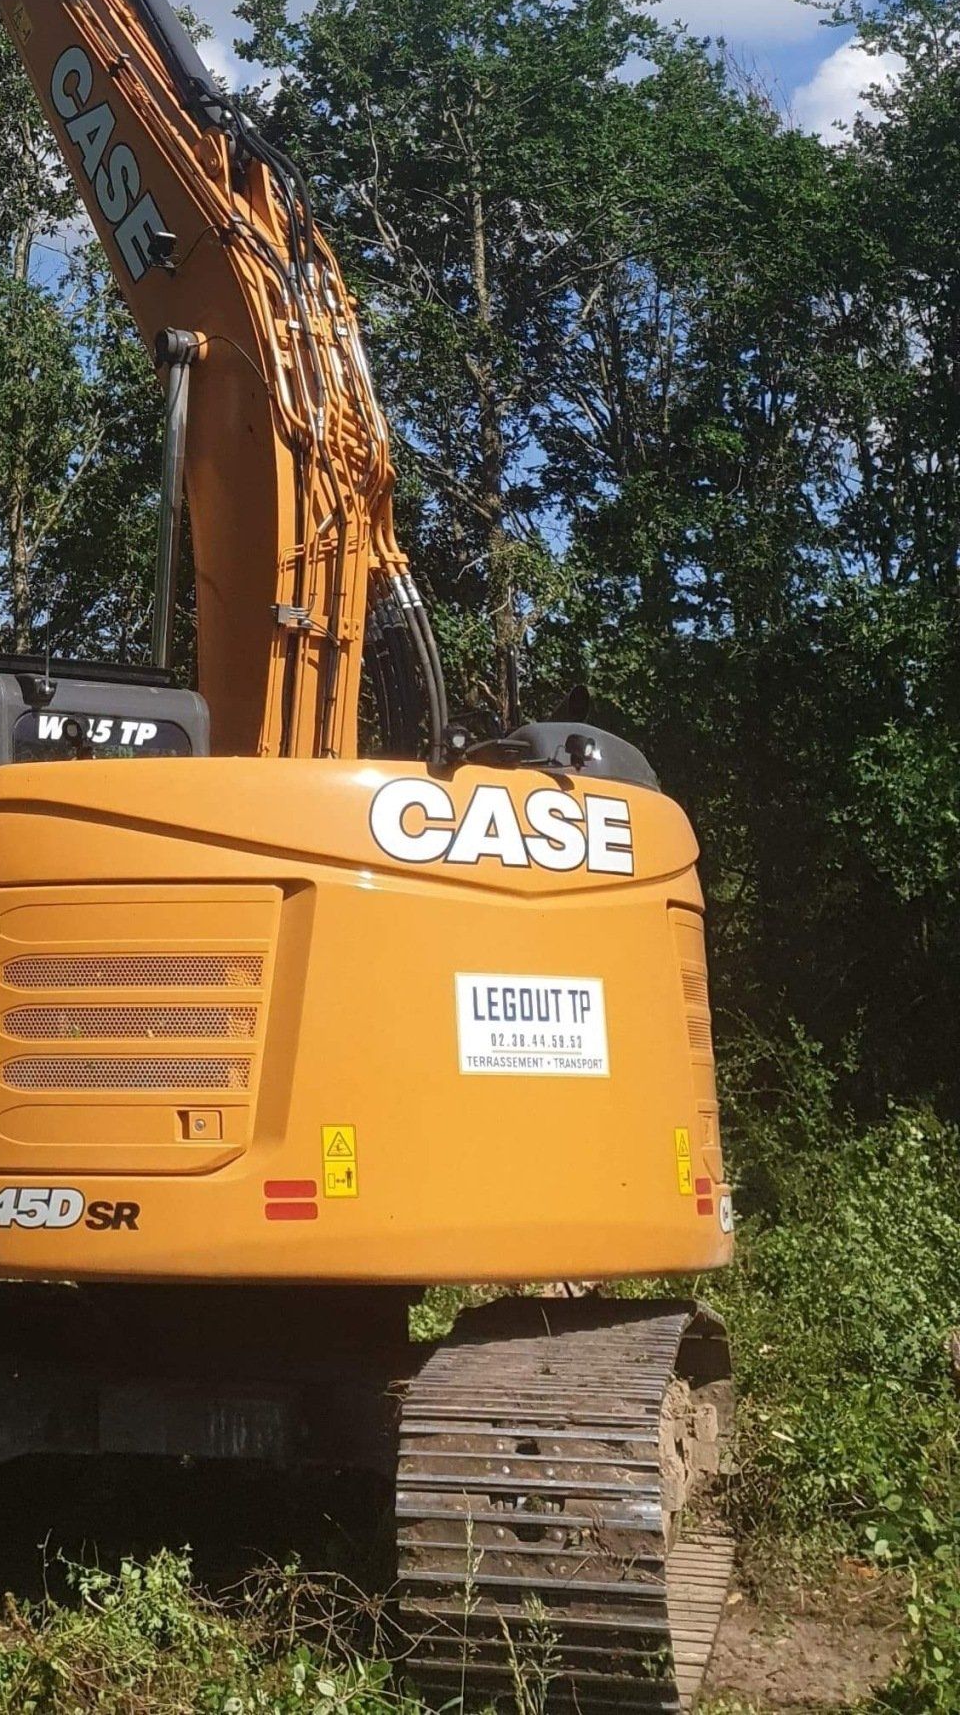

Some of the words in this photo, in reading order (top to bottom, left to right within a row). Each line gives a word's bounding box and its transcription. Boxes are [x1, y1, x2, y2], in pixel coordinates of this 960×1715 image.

[51, 44, 174, 282] CASE
[120, 722, 157, 745] TP
[369, 777, 634, 876] CASE
[472, 986, 562, 1023] LEGOUT
[568, 990, 591, 1024] TP
[467, 1055, 544, 1069] TERRASSEMENT
[554, 1057, 603, 1070] TRANSPORT
[85, 1201, 140, 1231] SR
